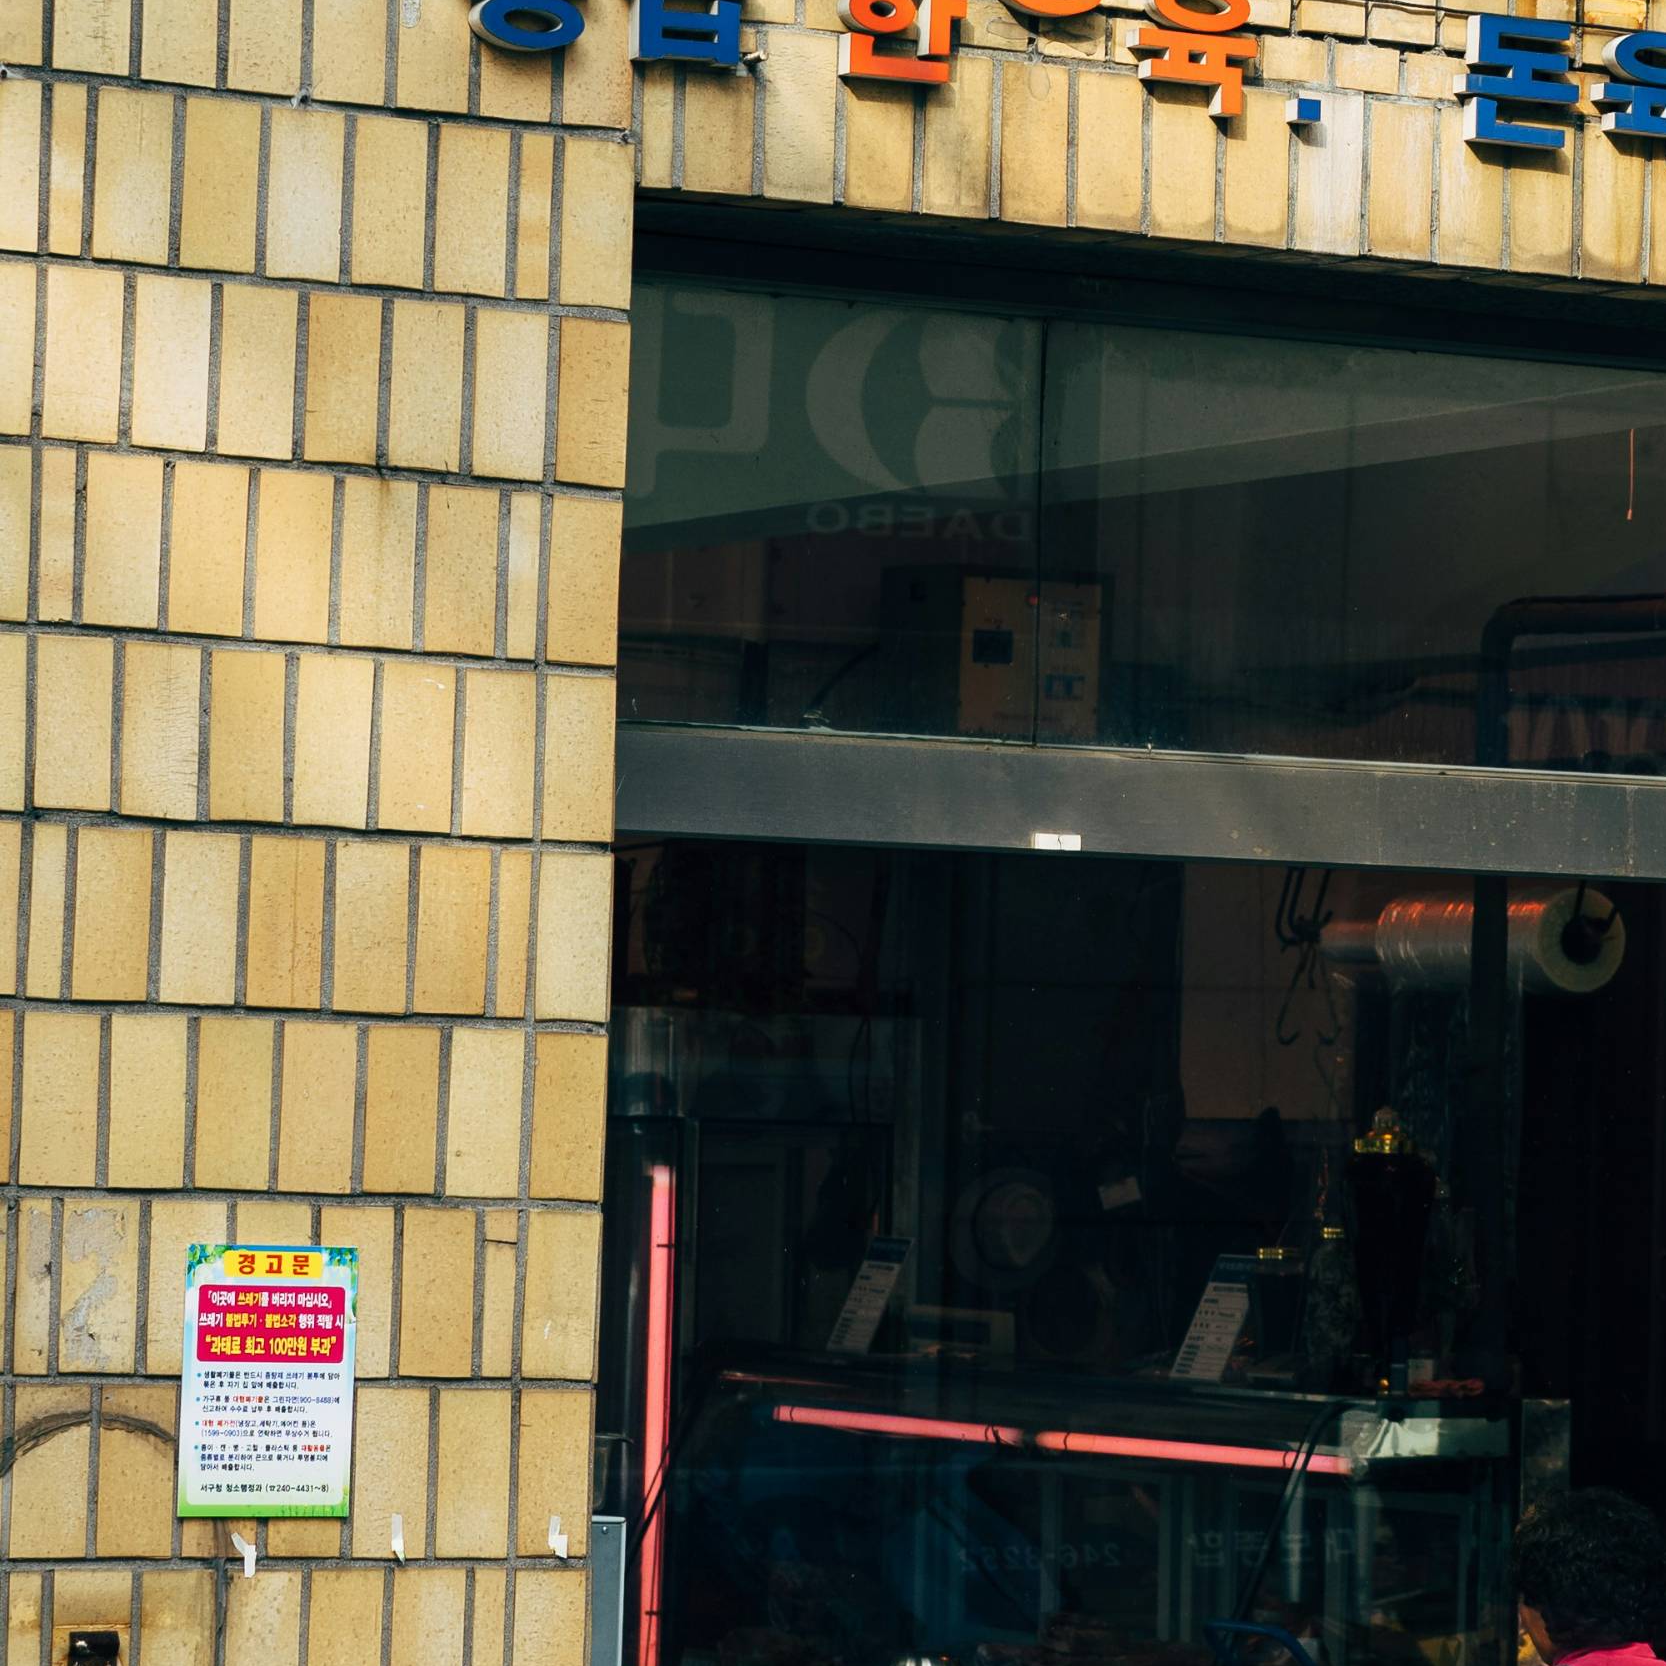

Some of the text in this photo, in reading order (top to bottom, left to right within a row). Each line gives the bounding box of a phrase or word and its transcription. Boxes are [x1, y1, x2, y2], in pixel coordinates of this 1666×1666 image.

[237, 1253, 310, 1275] 경고문
[237, 1291, 269, 1307] 쓰레기를
[271, 1292, 295, 1307] 버리지
[199, 1312, 223, 1327] 쓰레기
[298, 1314, 315, 1329] 행위
[317, 1314, 333, 1329] 적발
[335, 1314, 344, 1329] 시
[244, 1336, 265, 1356] 최고
[269, 1336, 307, 1356] 100만원
[200, 1484, 223, 1493] 서구청
[226, 1484, 262, 1493] 청소행정과
